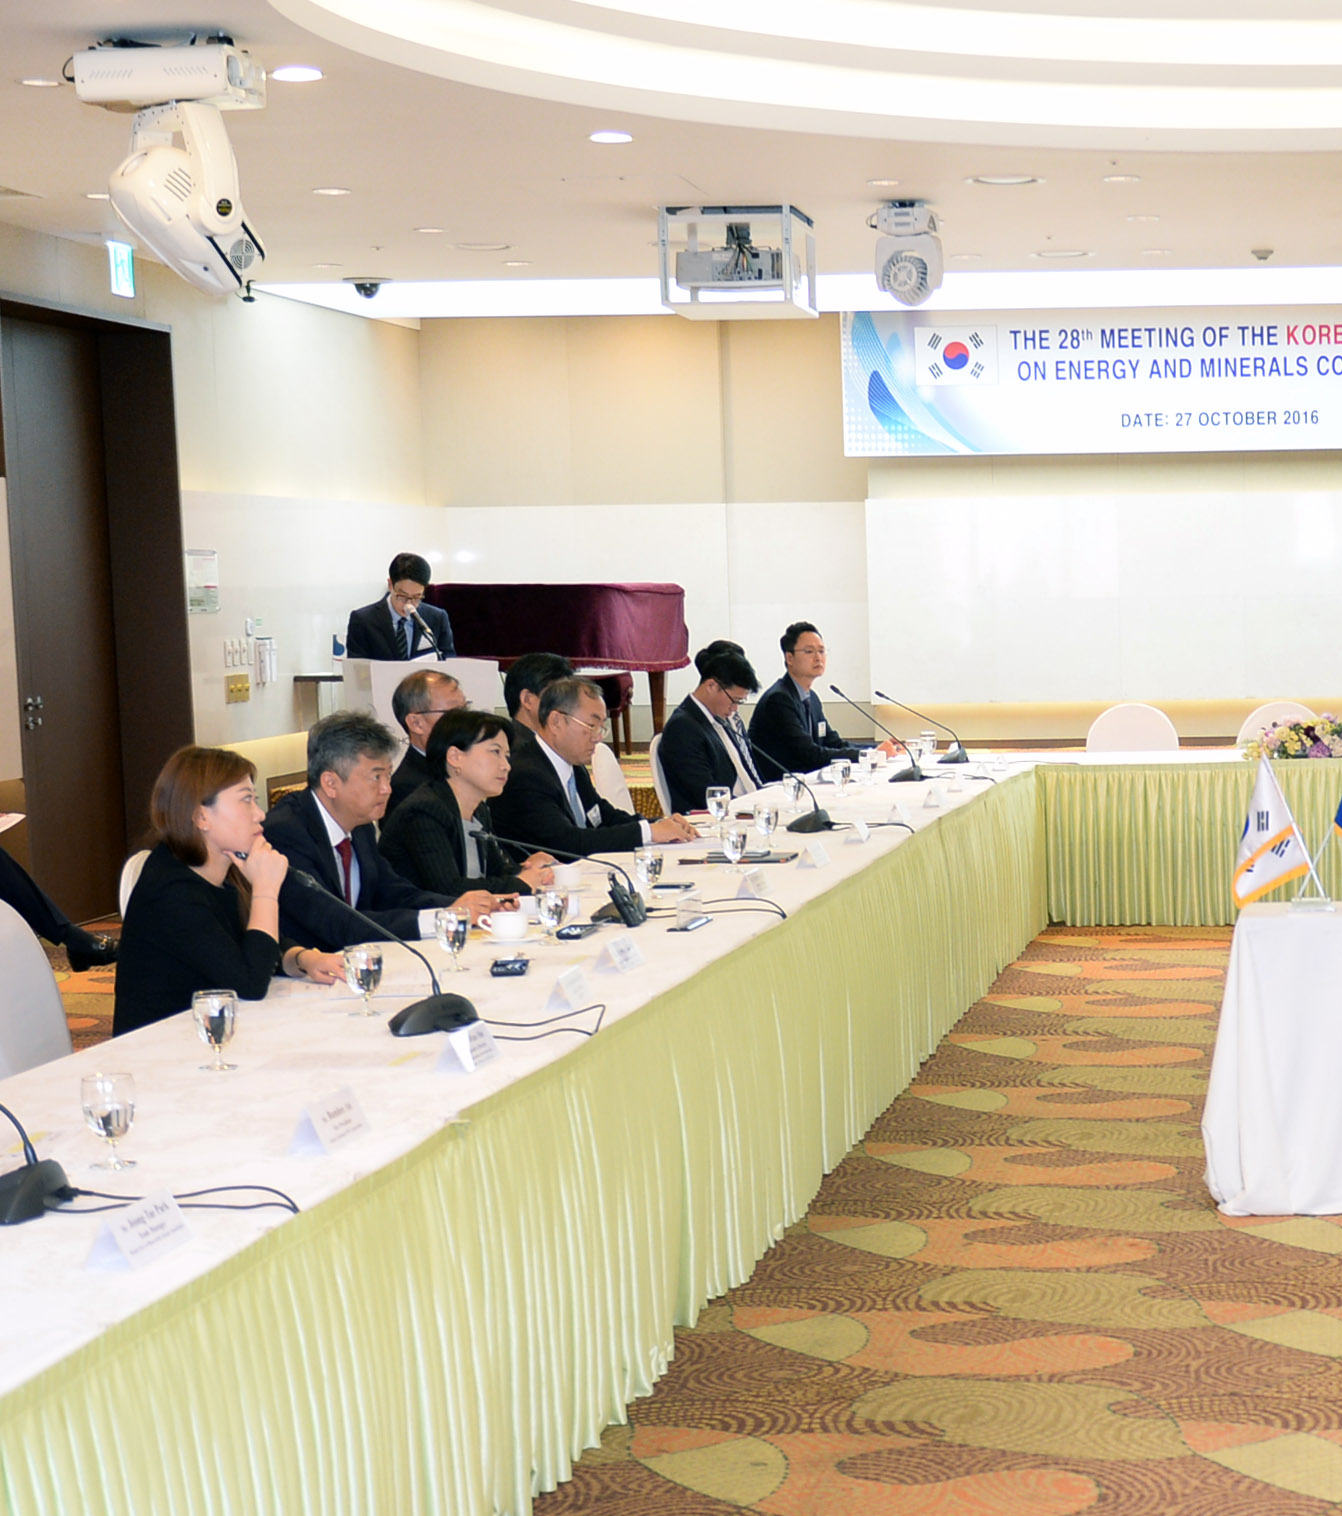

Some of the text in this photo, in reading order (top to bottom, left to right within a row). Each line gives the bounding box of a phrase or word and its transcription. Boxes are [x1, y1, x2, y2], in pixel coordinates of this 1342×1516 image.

[1009, 329, 1051, 350] THE
[1058, 328, 1093, 350] 28th
[1100, 327, 1195, 349] MEETING
[1202, 326, 1230, 348] OF
[1236, 325, 1279, 347] THE
[1017, 360, 1047, 382] ON
[1055, 359, 1140, 381] ENERGY
[1148, 358, 1193, 380] AND
[1200, 356, 1309, 379] MINERALS
[1121, 413, 1169, 428] DATE:
[1175, 412, 1193, 427] 27
[1198, 410, 1277, 427] OCTOBER
[1283, 409, 1319, 425] 2016
